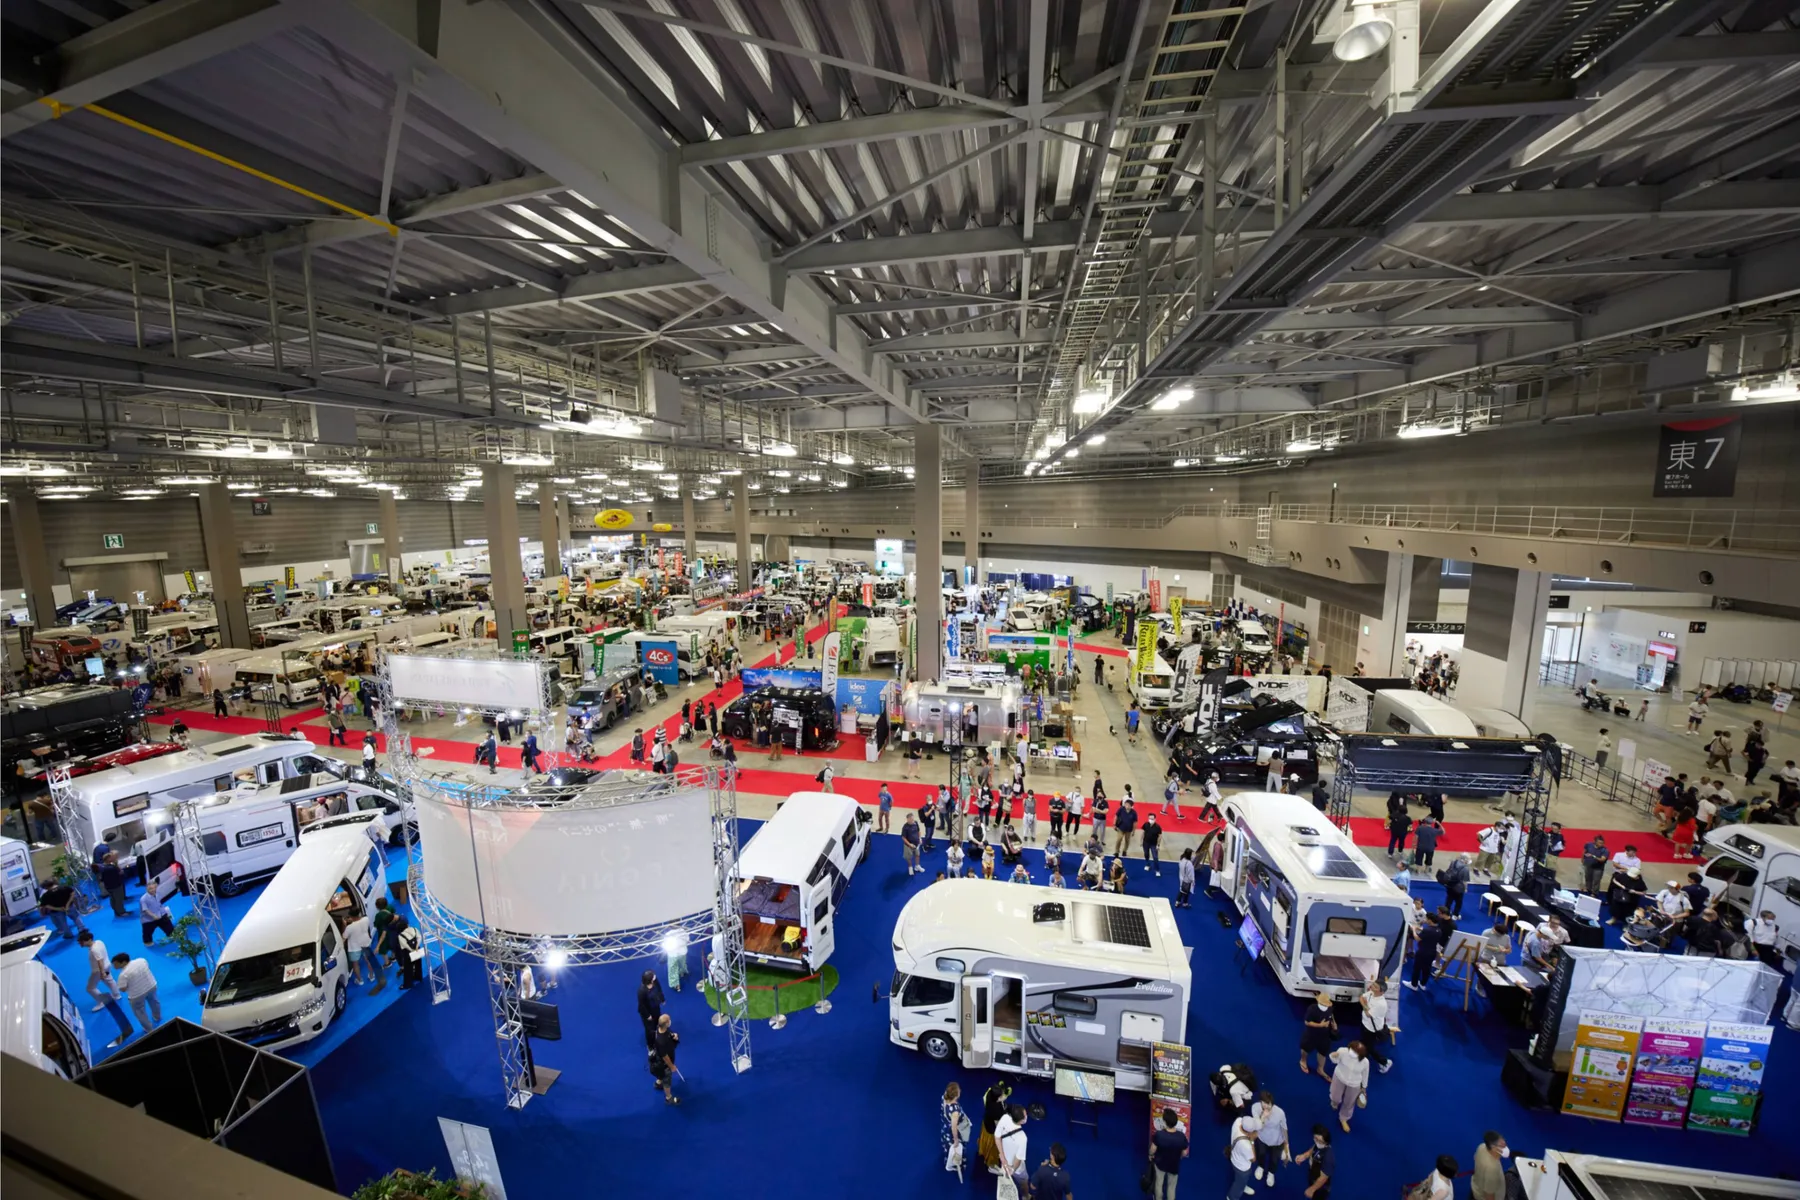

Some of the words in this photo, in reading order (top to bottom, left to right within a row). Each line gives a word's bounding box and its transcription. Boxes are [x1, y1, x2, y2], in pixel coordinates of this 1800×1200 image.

[1415, 623, 1463, 631] イーストショッ
[1258, 681, 1289, 689] MDF
[1339, 690, 1357, 704] MDF
[1134, 981, 1174, 994] Evolution
